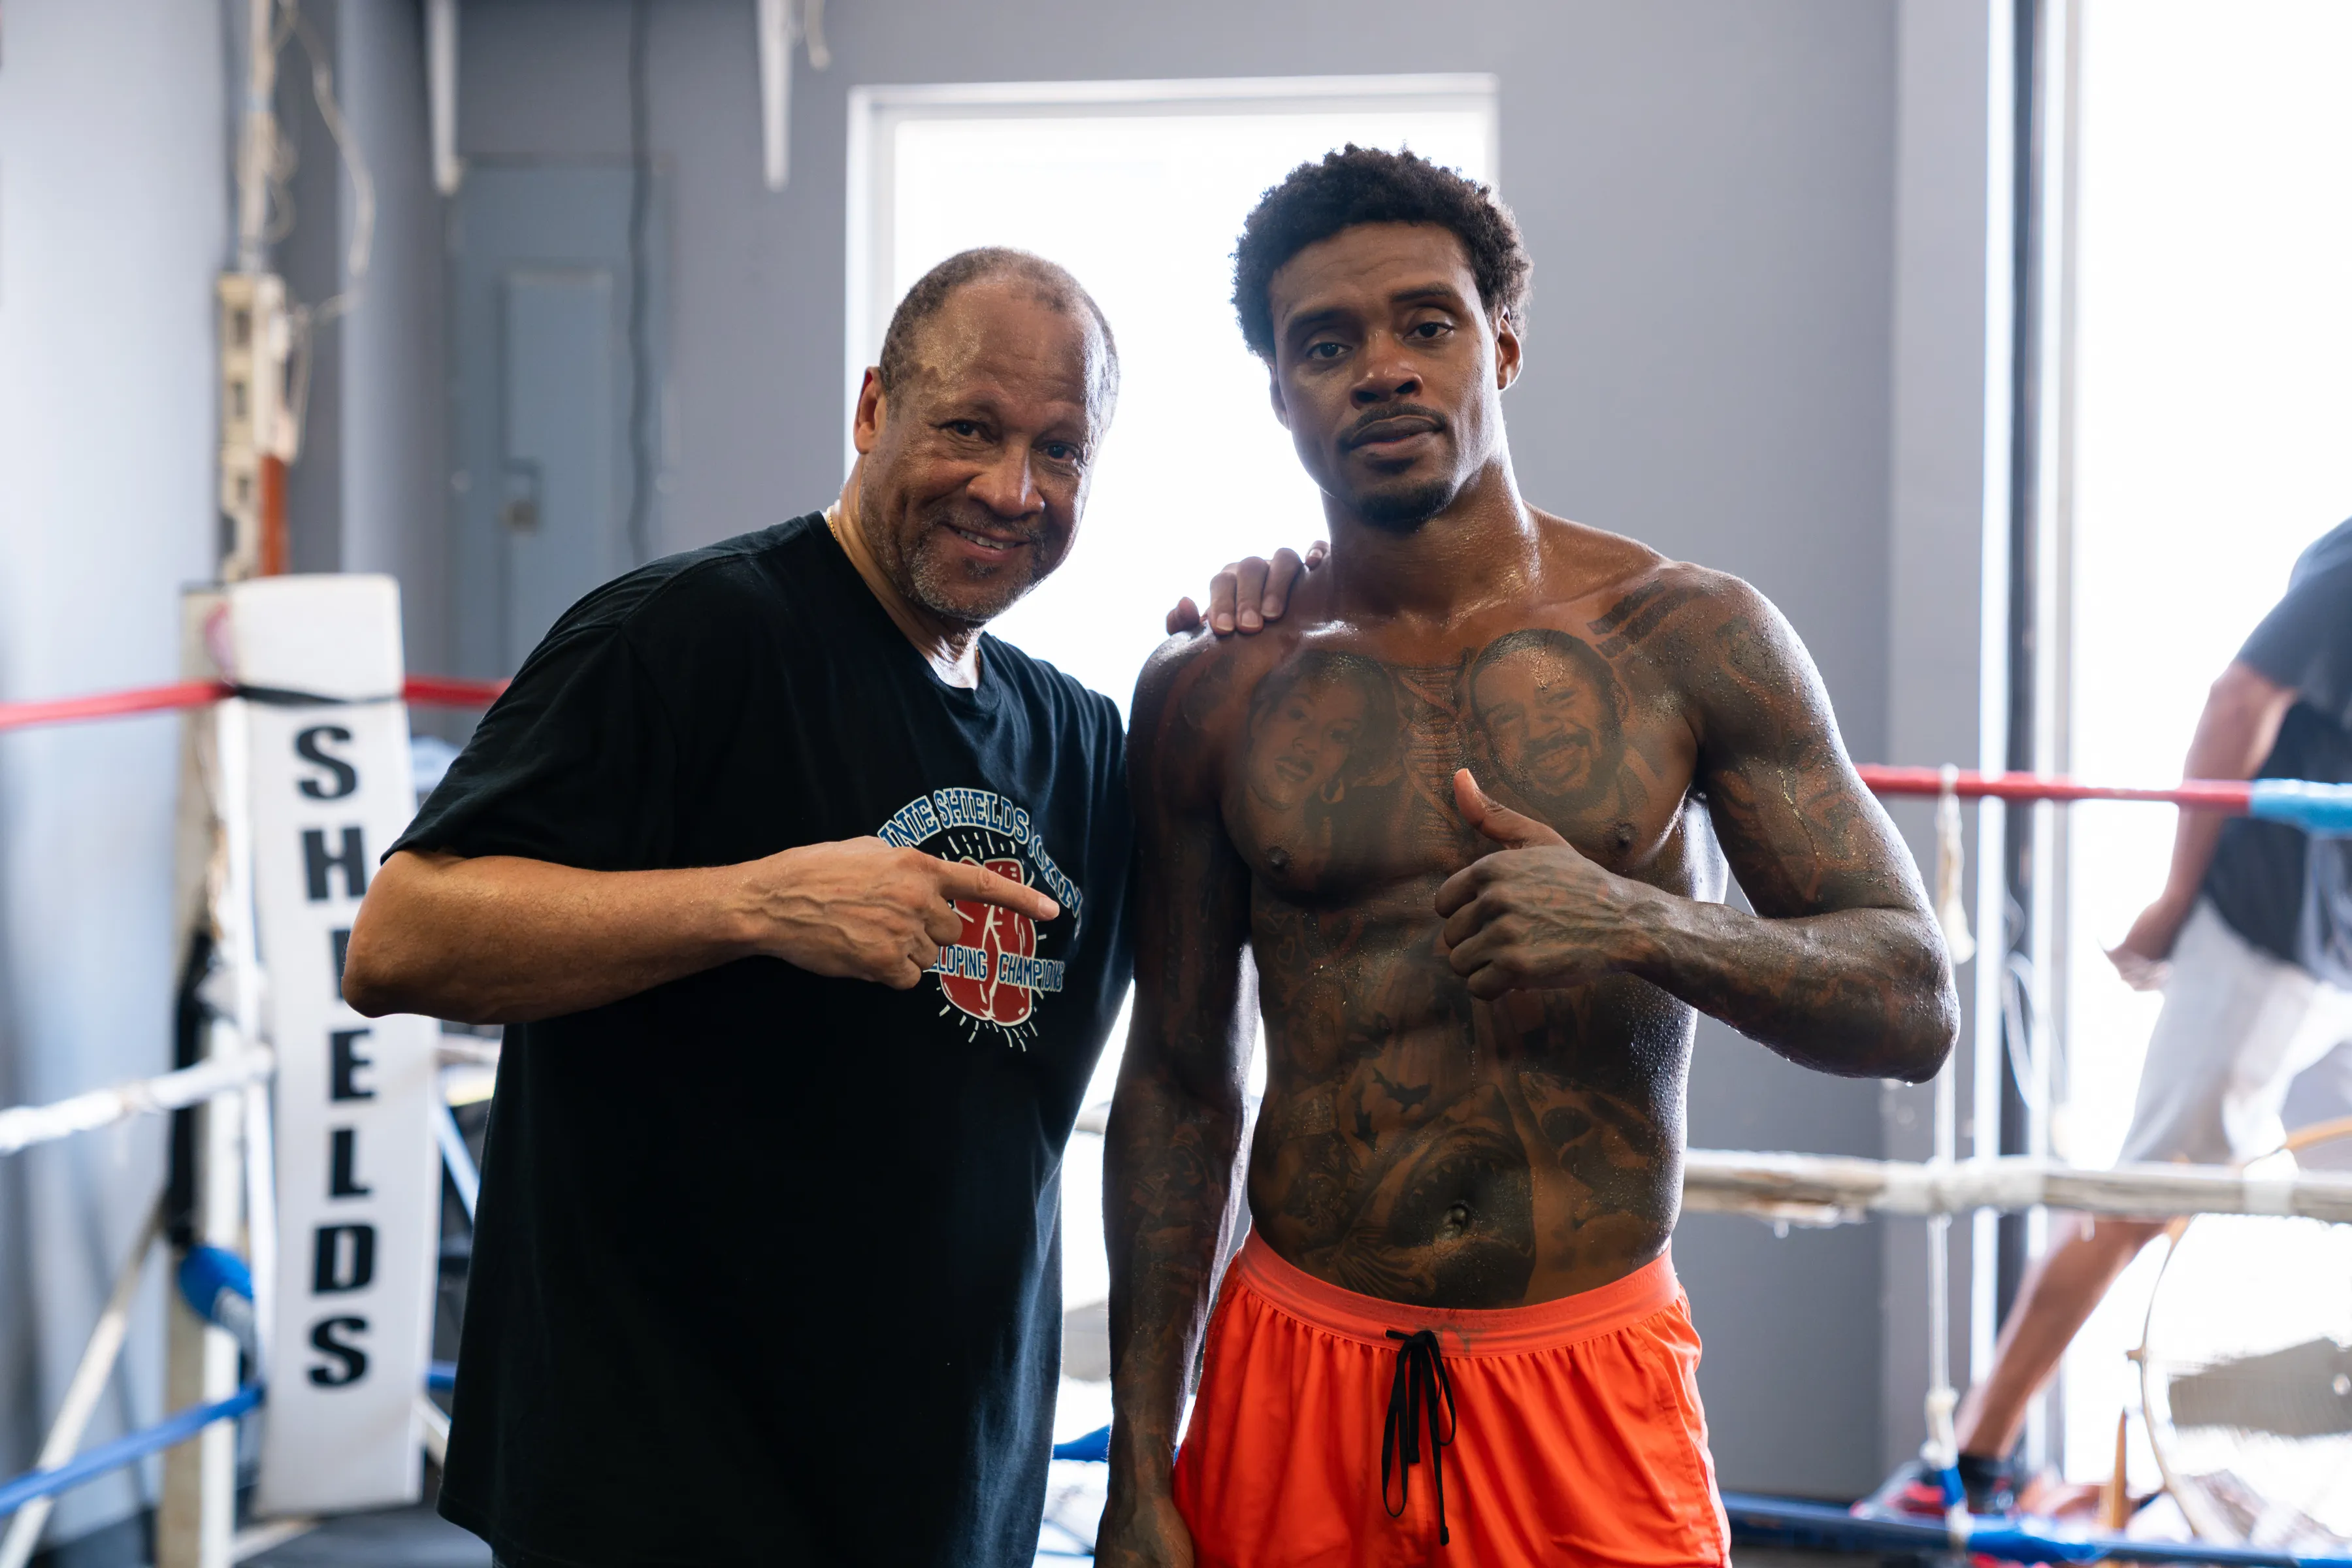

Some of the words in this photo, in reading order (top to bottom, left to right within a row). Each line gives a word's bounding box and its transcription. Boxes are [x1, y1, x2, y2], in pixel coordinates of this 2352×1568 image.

[933, 787, 1030, 845] SHIELDS
[1028, 825, 1083, 941] OXIN
[923, 943, 988, 983] LOPING
[998, 951, 1066, 992] CHAMPIONS
